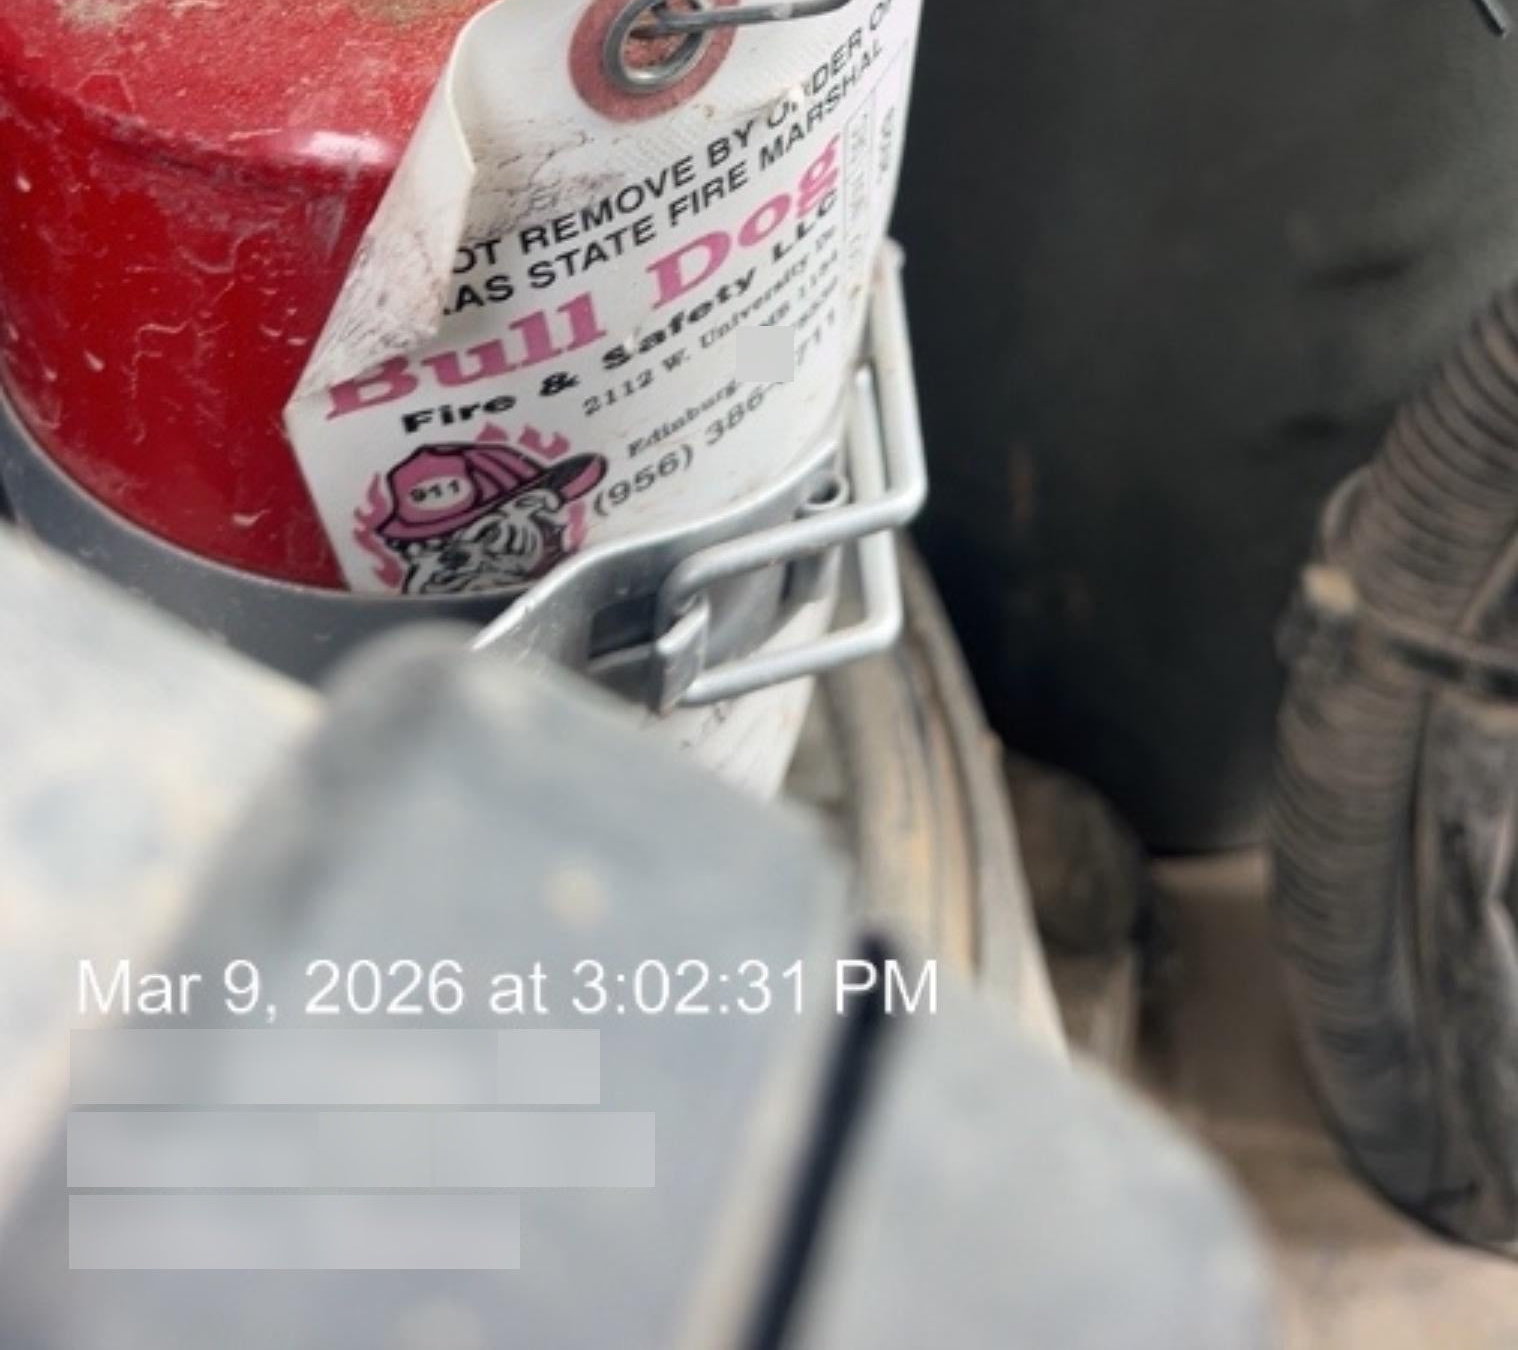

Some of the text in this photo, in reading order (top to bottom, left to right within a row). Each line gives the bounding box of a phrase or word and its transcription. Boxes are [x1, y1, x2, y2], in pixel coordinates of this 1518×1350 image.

[443, 275, 516, 317] AS
[527, 213, 657, 290] STATE
[669, 159, 749, 229] FIRE
[759, 37, 883, 172] MARSHAL
[451, 238, 502, 275] OT
[519, 154, 696, 256] REMOVE
[707, 119, 754, 169] BY
[325, 290, 607, 422] Bull
[645, 132, 840, 311] Dog
[401, 394, 517, 435] Fire
[538, 371, 581, 397] &
[602, 266, 756, 371] Safety
[771, 188, 837, 263] LLC
[582, 368, 653, 418] 2112
[699, 251, 809, 350] University
[409, 479, 460, 504] 911
[593, 443, 694, 518] (956)
